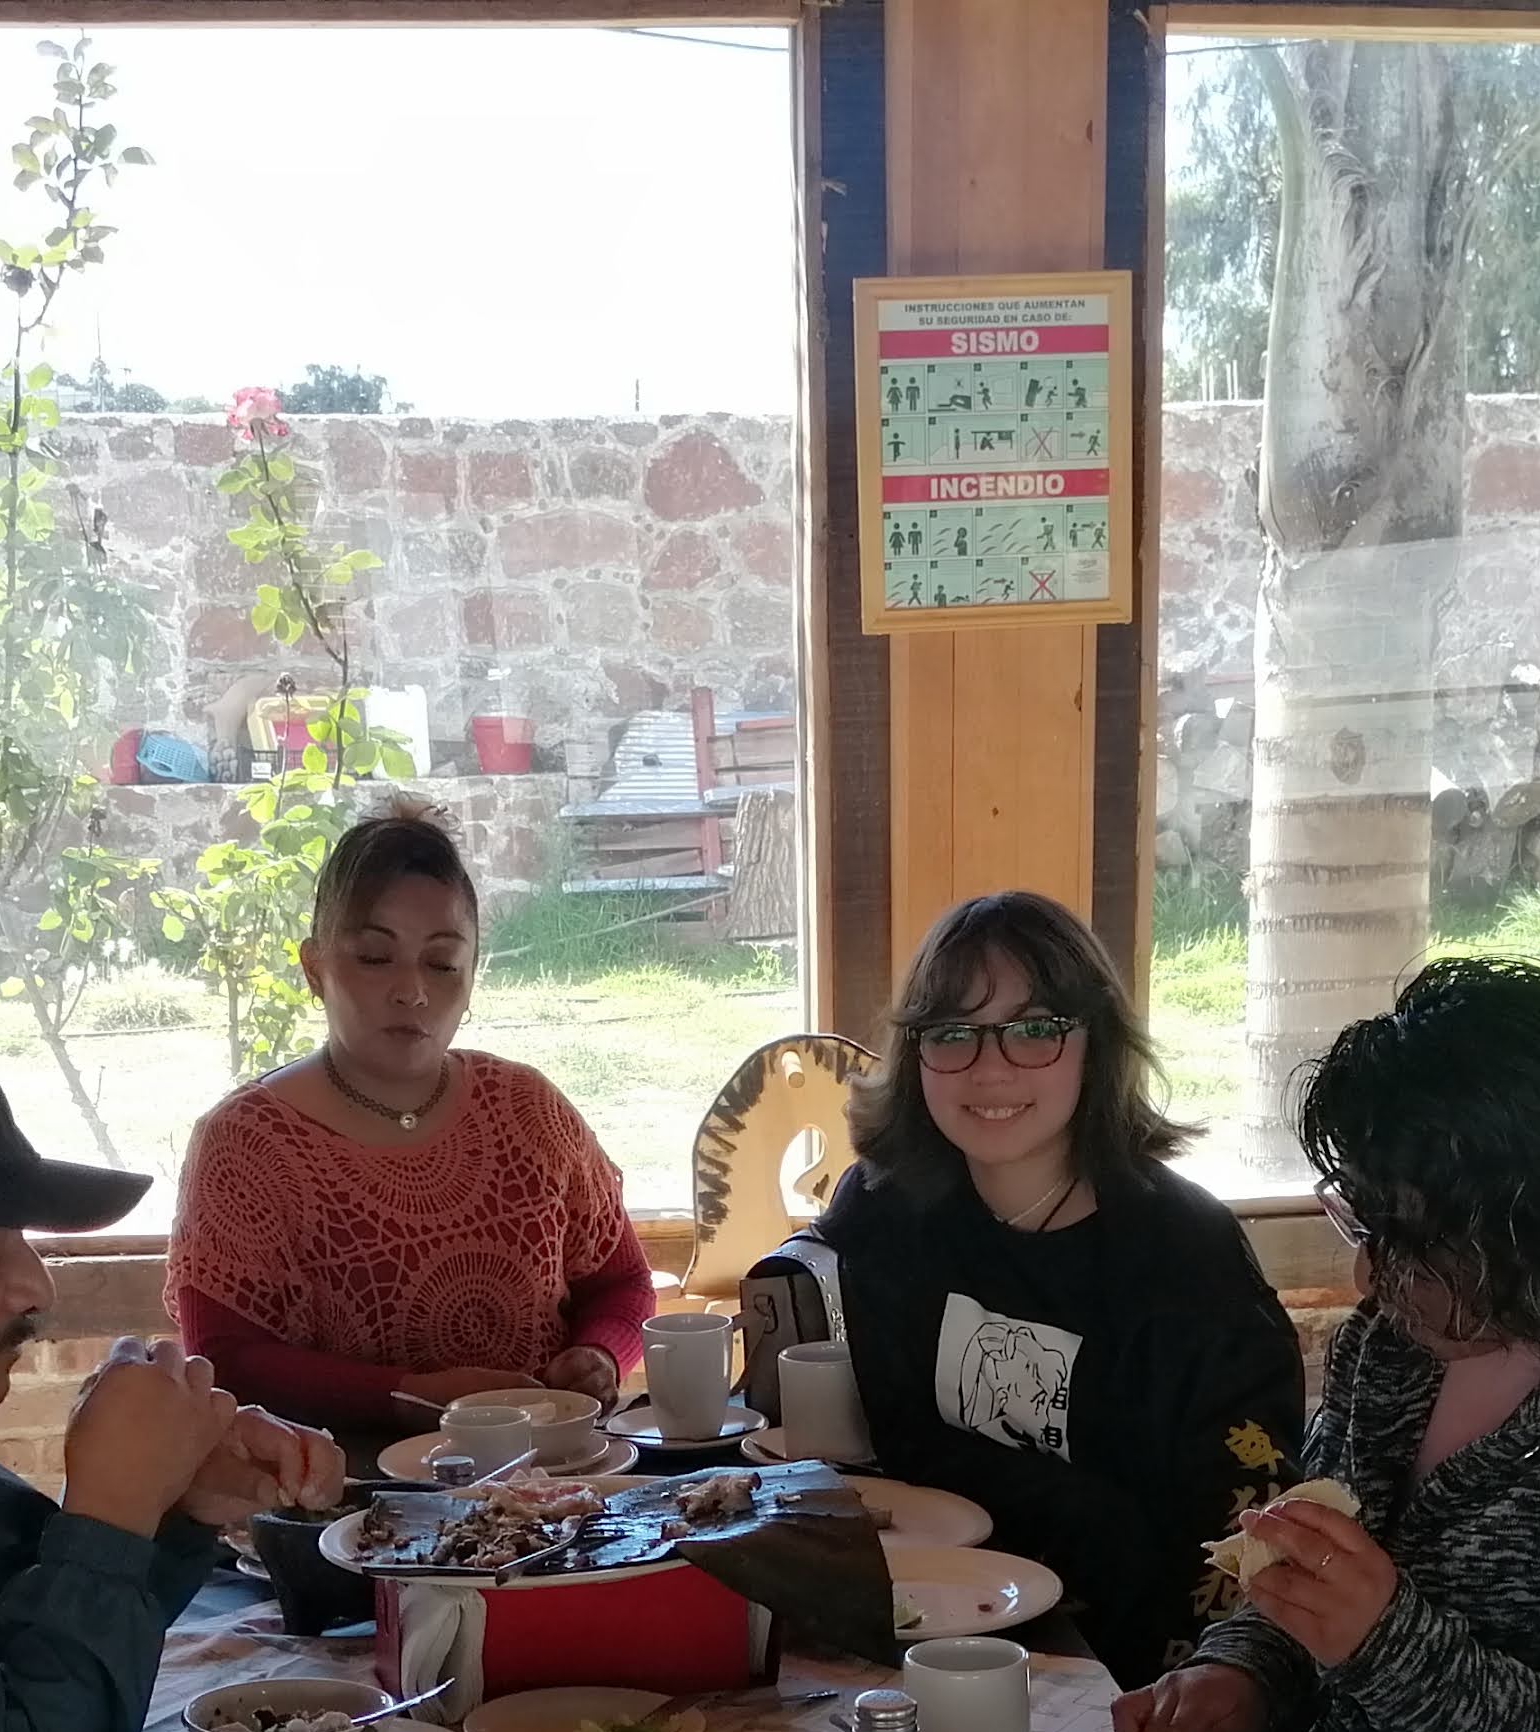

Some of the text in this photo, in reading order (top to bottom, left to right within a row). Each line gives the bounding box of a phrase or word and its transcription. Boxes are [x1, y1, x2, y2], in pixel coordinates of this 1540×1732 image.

[904, 299, 1086, 313] INSTRUCCIONES QUE AUMENTAN
[918, 316, 934, 326] SU
[936, 315, 1001, 325] SEGURIDAD
[1003, 314, 1018, 323] EN
[1021, 313, 1052, 323] CASO
[950, 329, 1040, 355] SISMO
[929, 473, 1066, 500] INCENDIO
